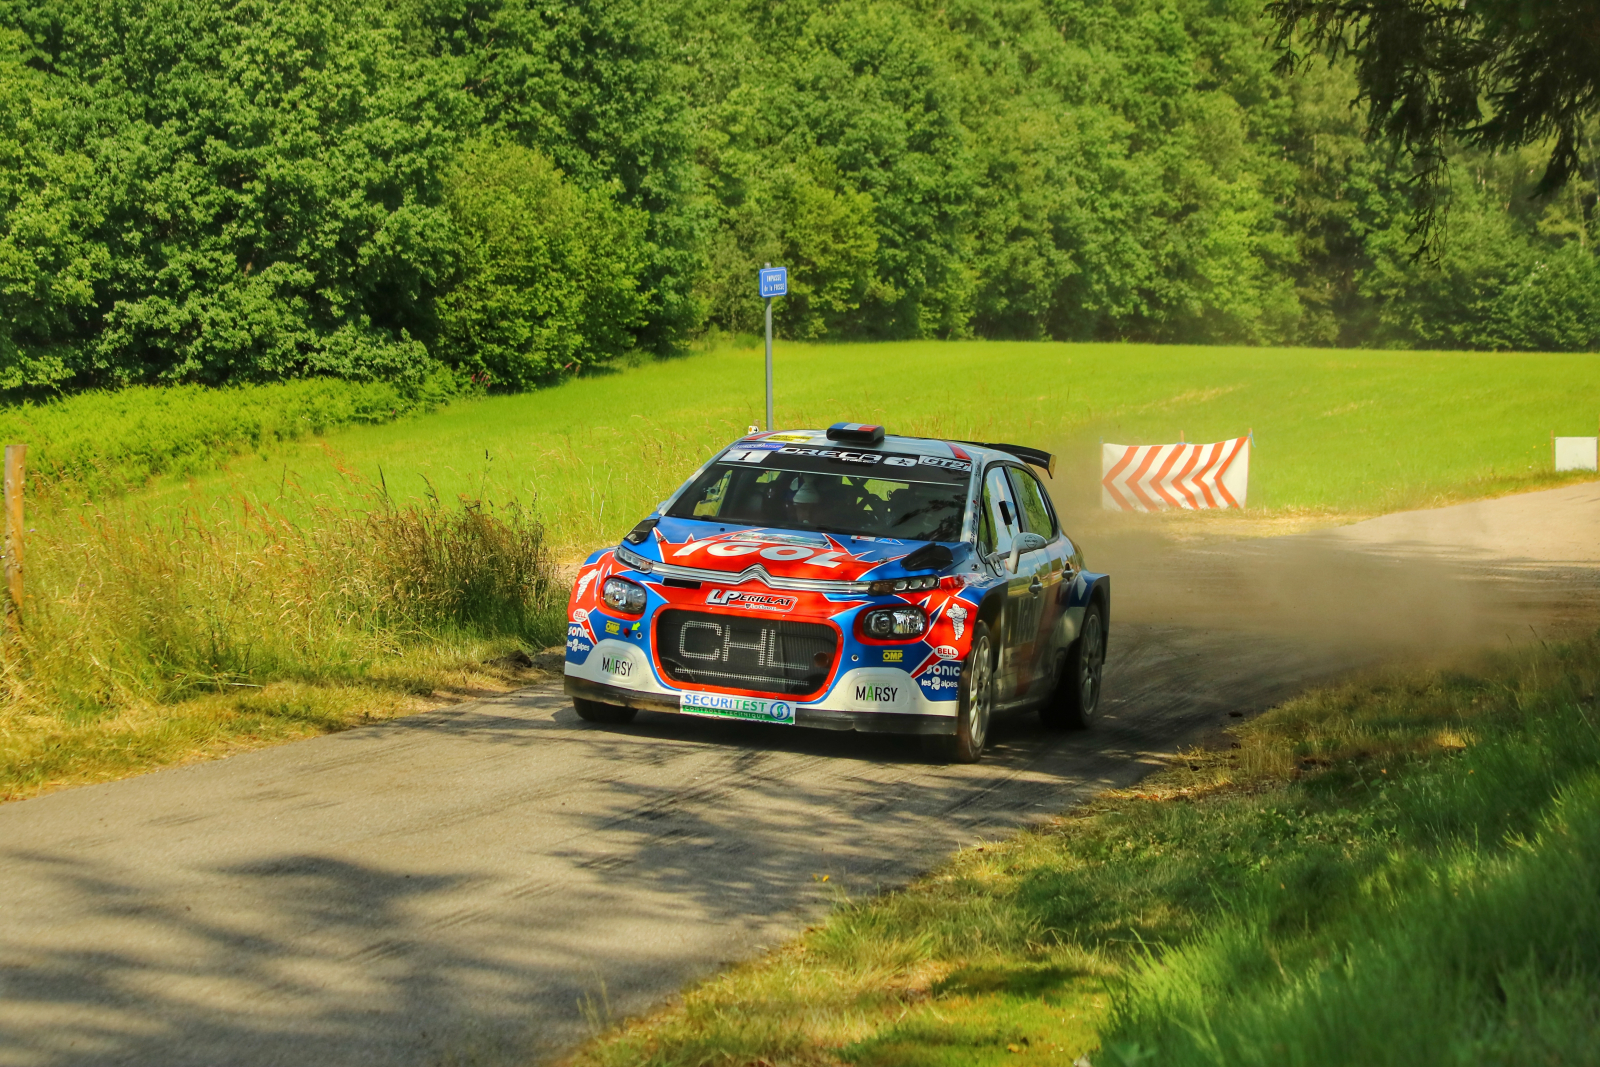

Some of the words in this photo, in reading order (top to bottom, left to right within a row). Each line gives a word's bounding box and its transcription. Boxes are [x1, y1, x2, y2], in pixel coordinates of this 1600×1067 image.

[738, 451, 752, 461] 1
[777, 447, 882, 463] ORECA
[672, 540, 848, 568] IGOL
[575, 610, 587, 619] BELL
[605, 622, 620, 633] OMP
[882, 652, 903, 660] OMP
[937, 647, 957, 656] BELL
[602, 656, 632, 677] MARSY
[921, 678, 932, 687] les
[931, 676, 941, 690] 2
[855, 685, 899, 702] MARSY
[684, 694, 768, 712] SECURITEST
